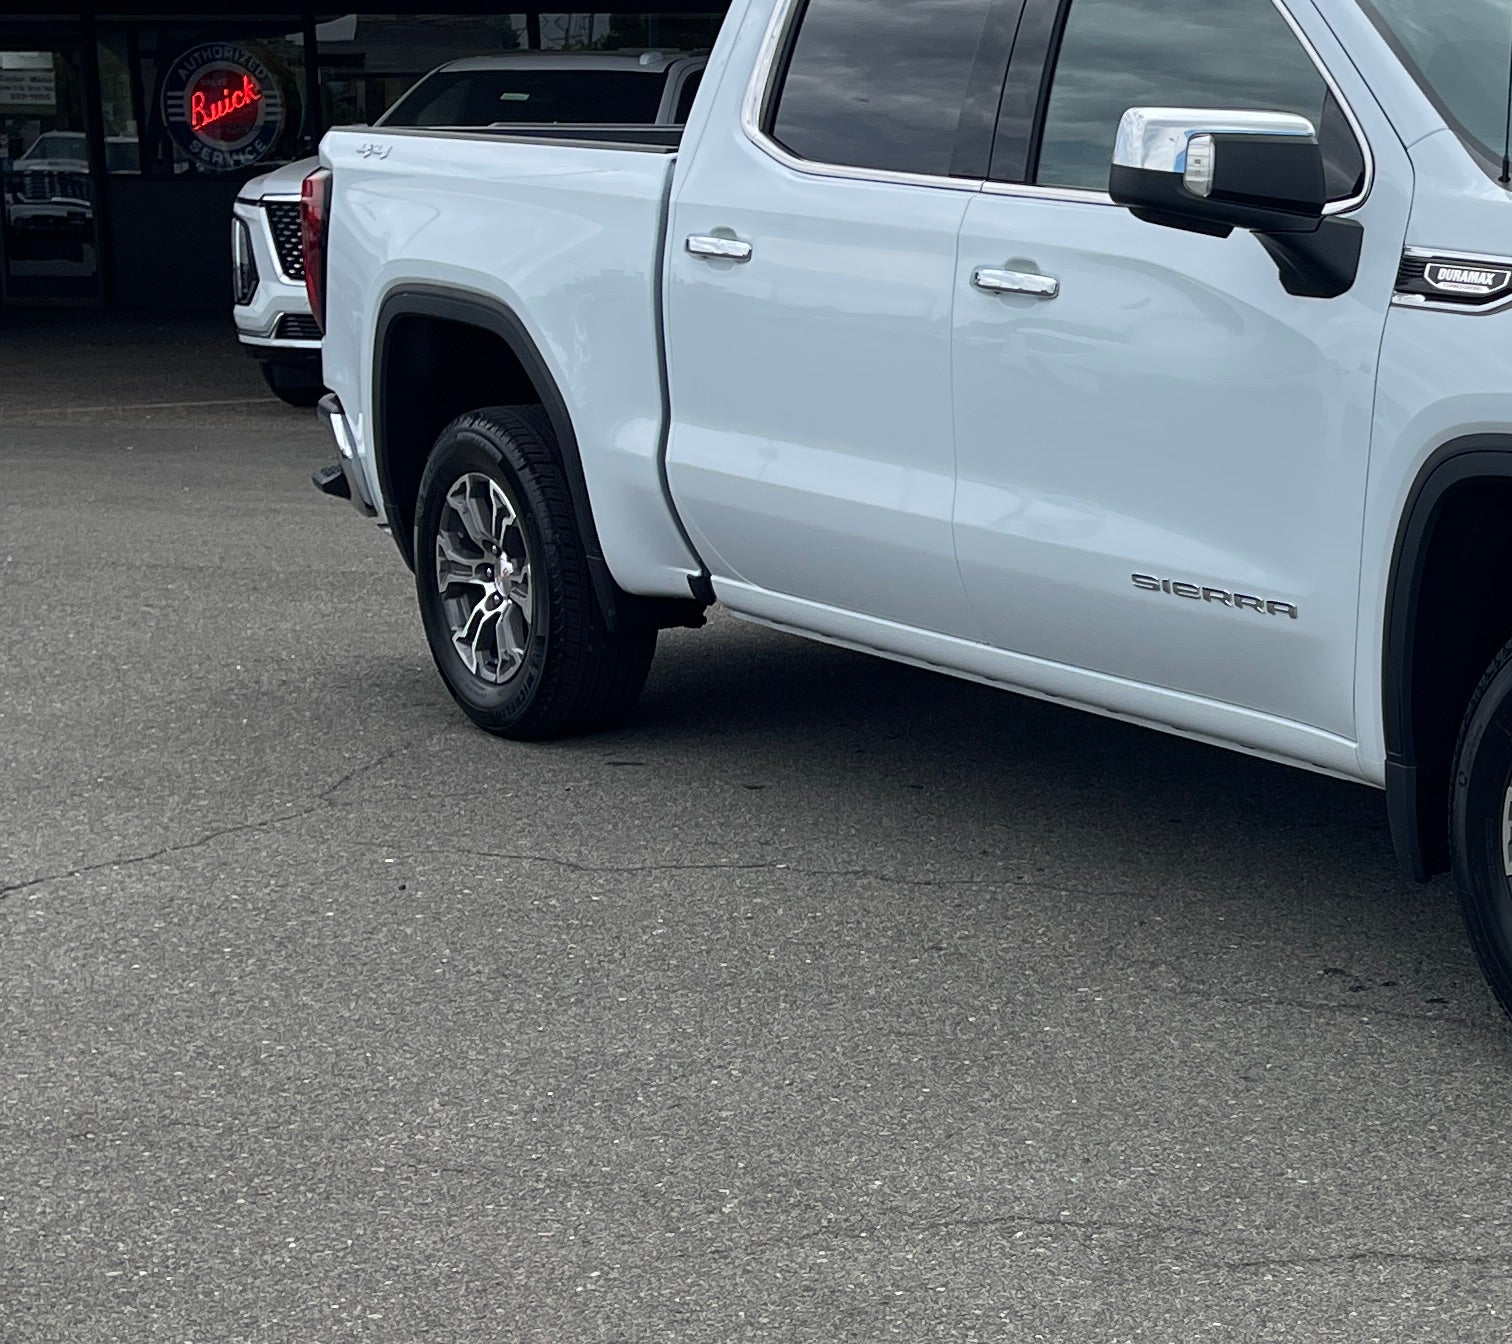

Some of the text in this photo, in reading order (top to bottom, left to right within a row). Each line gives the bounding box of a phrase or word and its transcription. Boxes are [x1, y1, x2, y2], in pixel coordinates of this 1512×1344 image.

[177, 46, 266, 82] AUTHORIZED
[190, 74, 262, 131] Buick
[189, 139, 267, 166] SERVICE
[1438, 268, 1495, 285] DURAMAX
[1131, 572, 1299, 620] SIERRA
